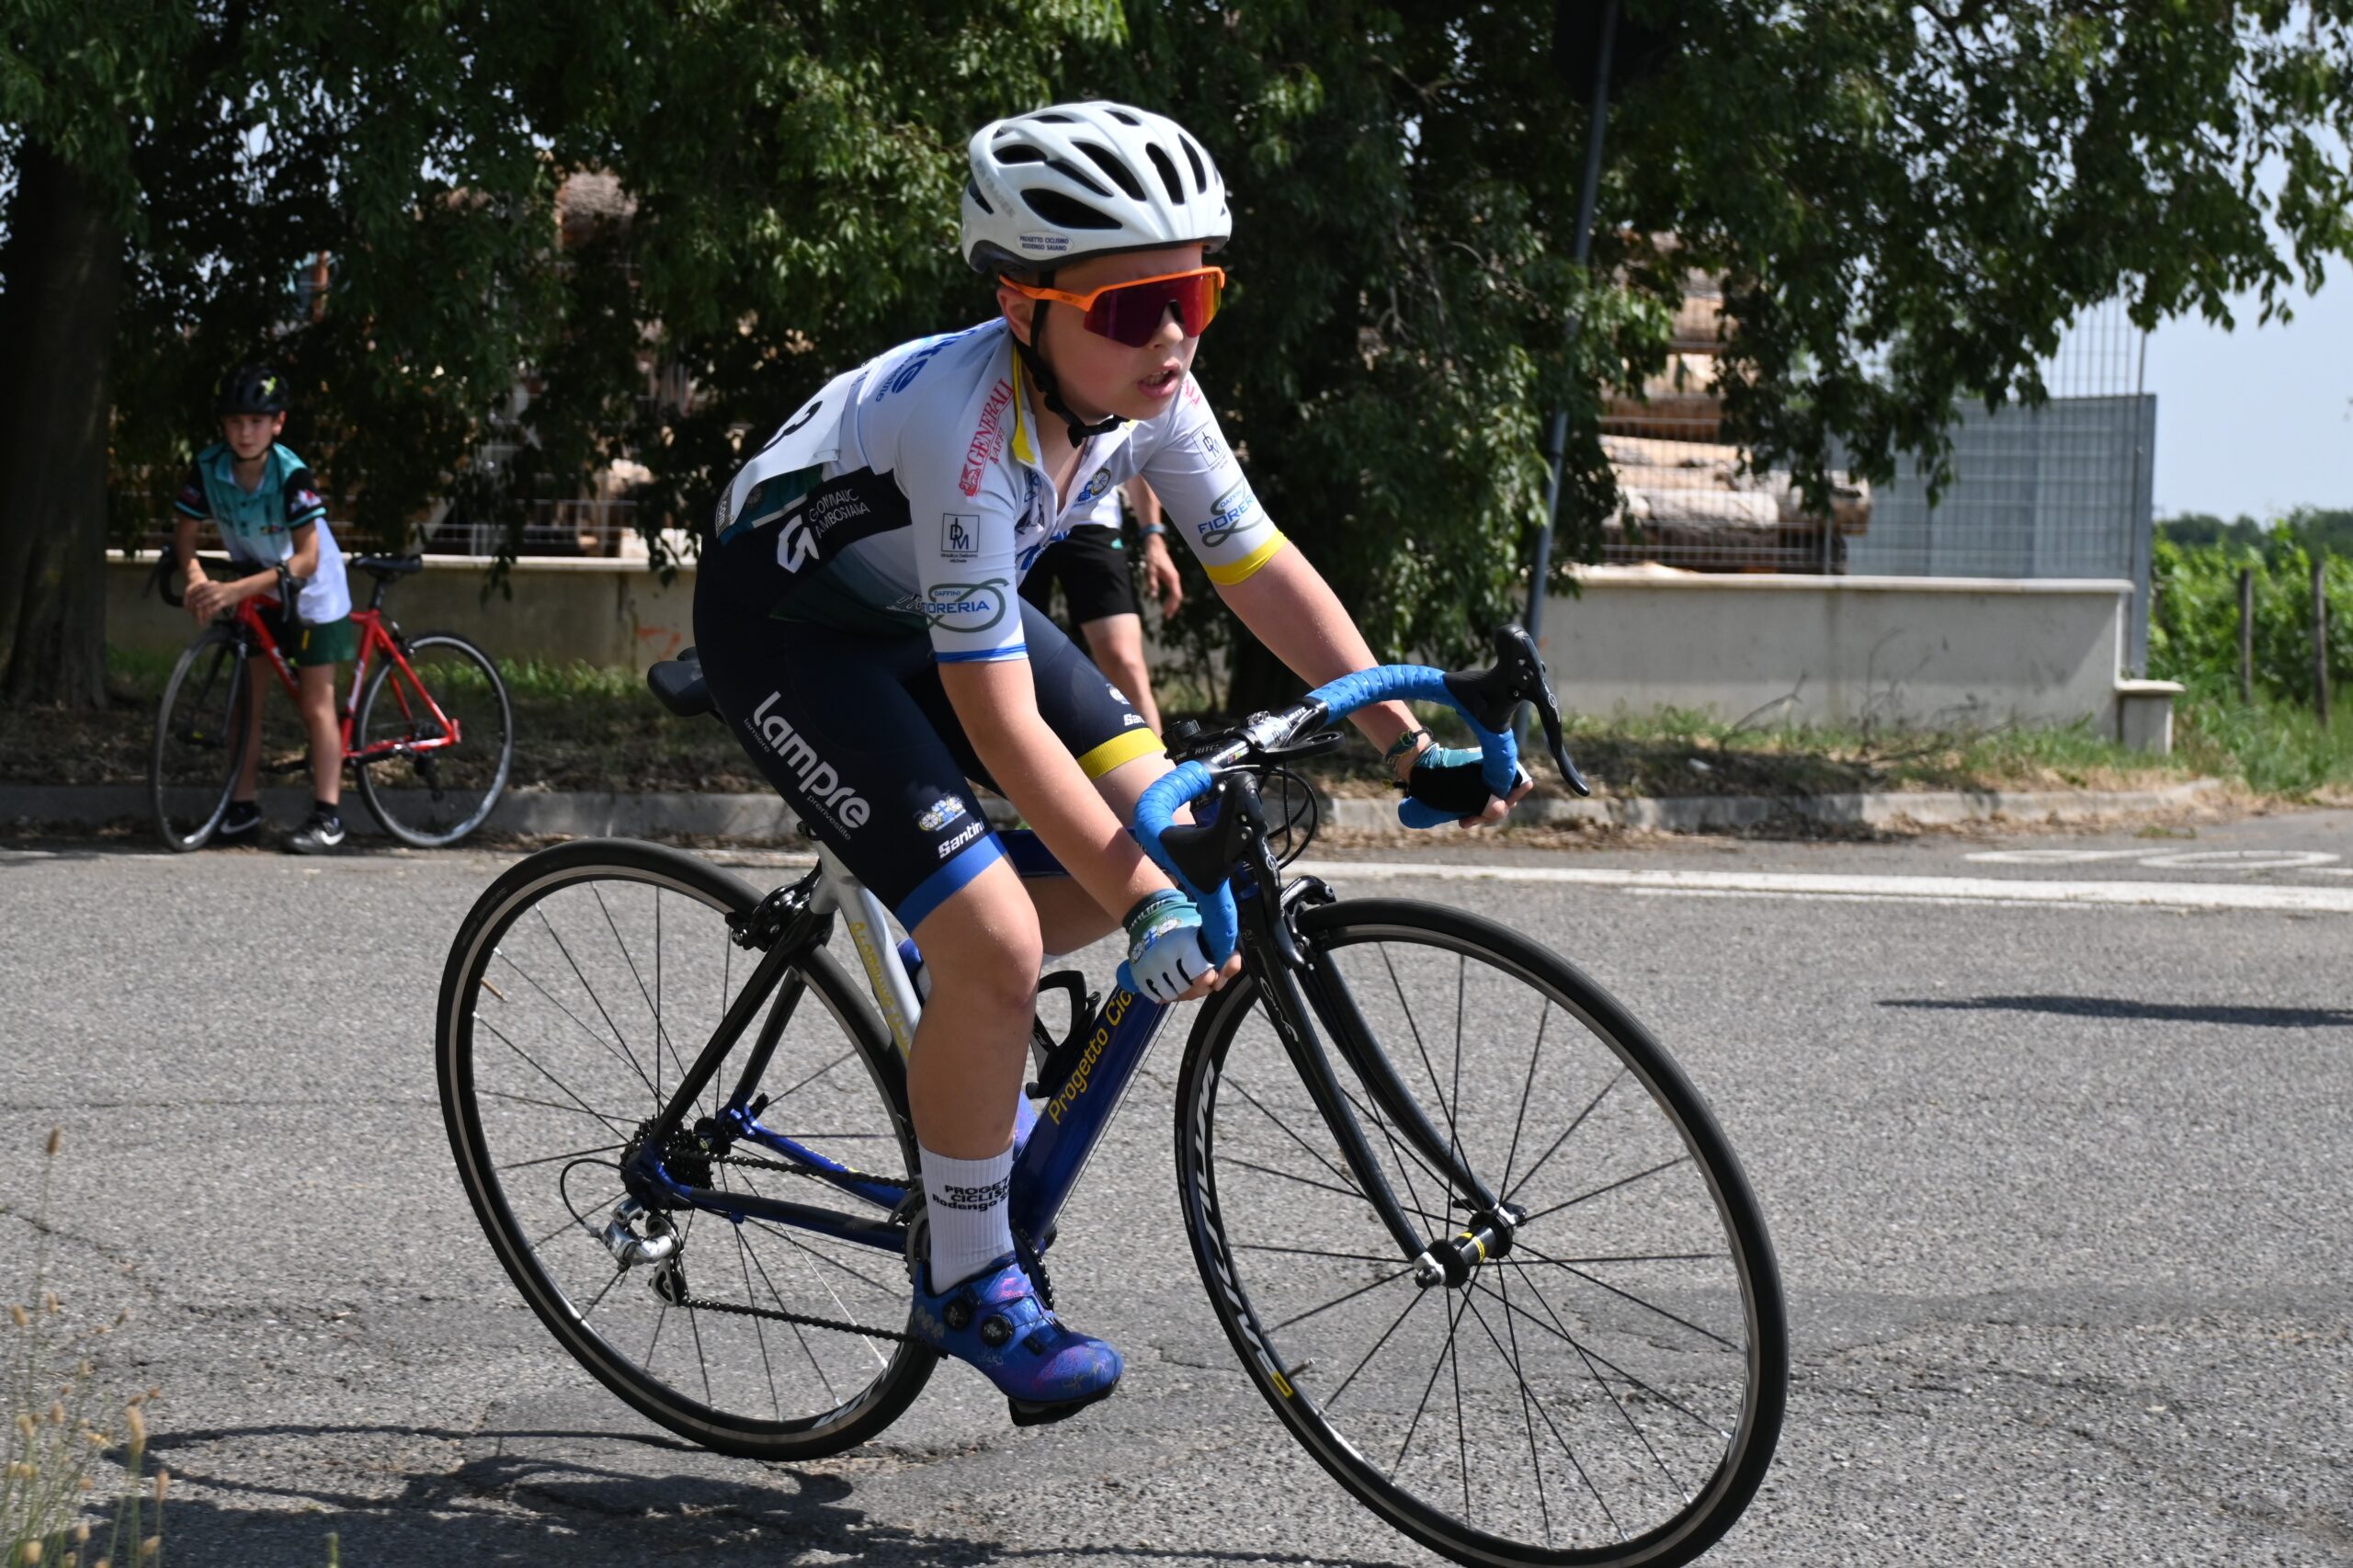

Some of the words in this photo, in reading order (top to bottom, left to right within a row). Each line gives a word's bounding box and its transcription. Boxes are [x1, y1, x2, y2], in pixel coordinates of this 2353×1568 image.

[967, 378, 1014, 466] GENERALI
[744, 718, 770, 753] lamiere
[807, 795, 851, 840] prerivestite
[938, 817, 985, 858] Santini
[1048, 1027, 1108, 1126] Progetto
[932, 1193, 997, 1211] Rodengo
